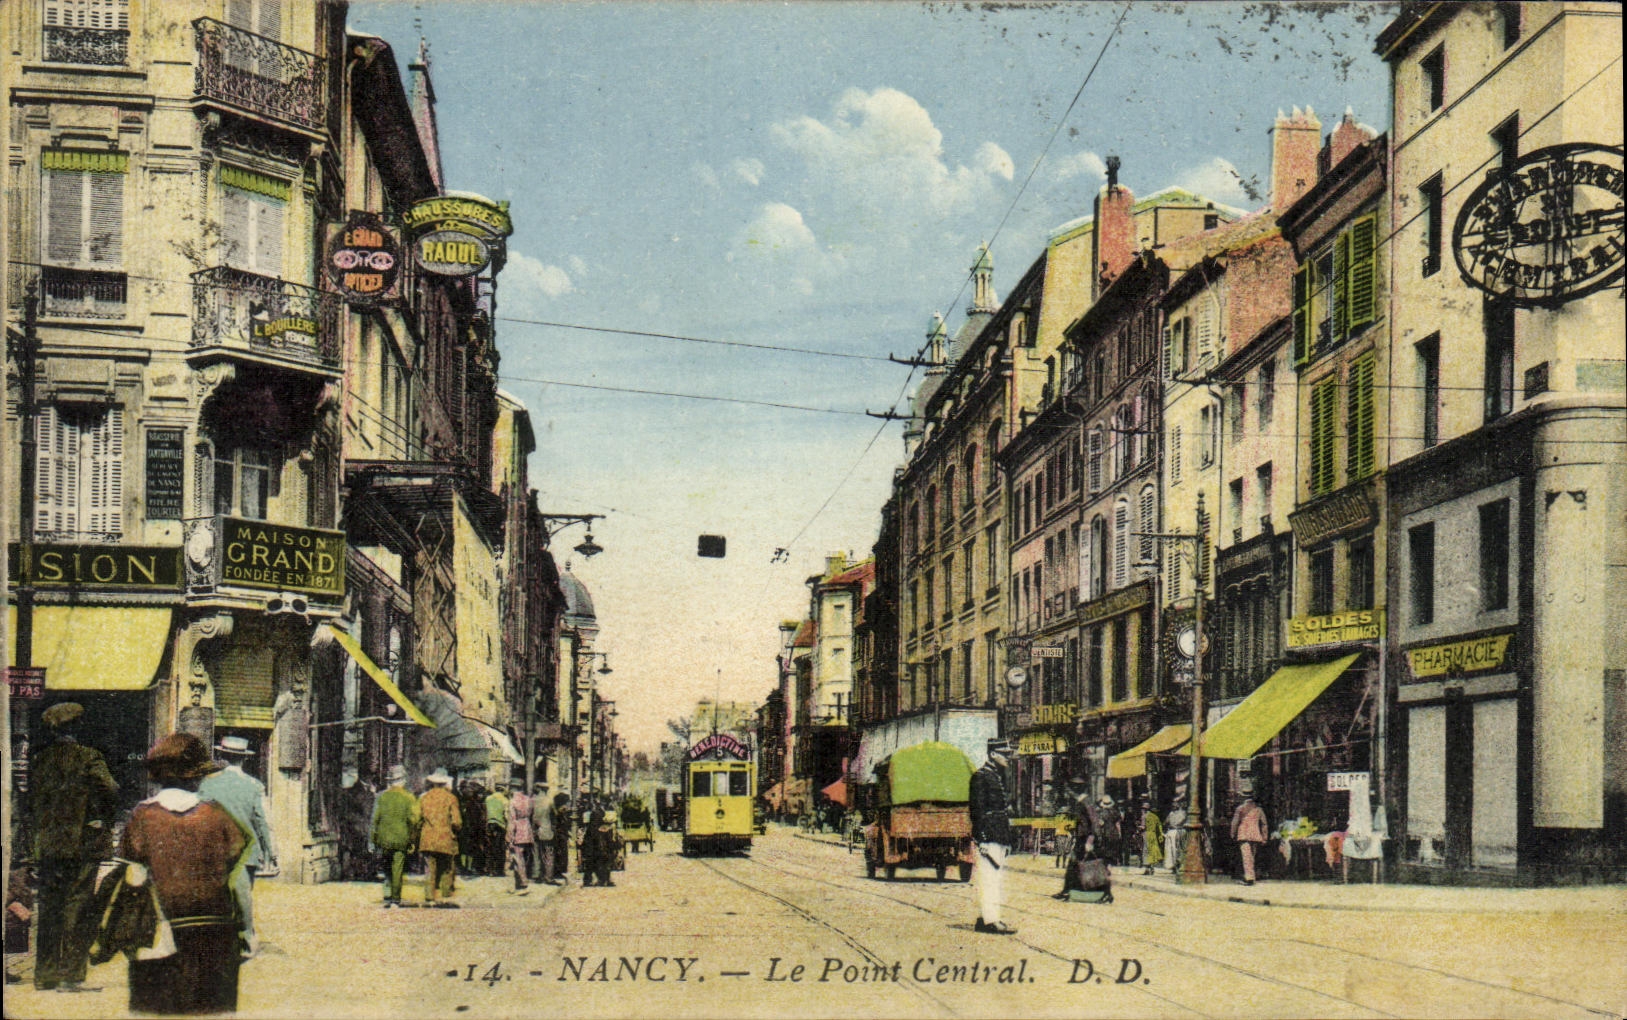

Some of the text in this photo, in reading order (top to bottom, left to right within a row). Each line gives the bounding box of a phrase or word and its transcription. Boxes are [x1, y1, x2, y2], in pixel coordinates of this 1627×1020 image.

[402, 201, 502, 227] CHAUSSURES
[422, 241, 480, 265] RAOUL
[237, 527, 327, 550] MAISON
[227, 541, 335, 575] GRAND
[225, 565, 334, 589] FONDÉE EN 1871
[1292, 611, 1372, 633] SOLDES
[1414, 640, 1500, 671] PHARMACIE
[716, 748, 723, 757] 5
